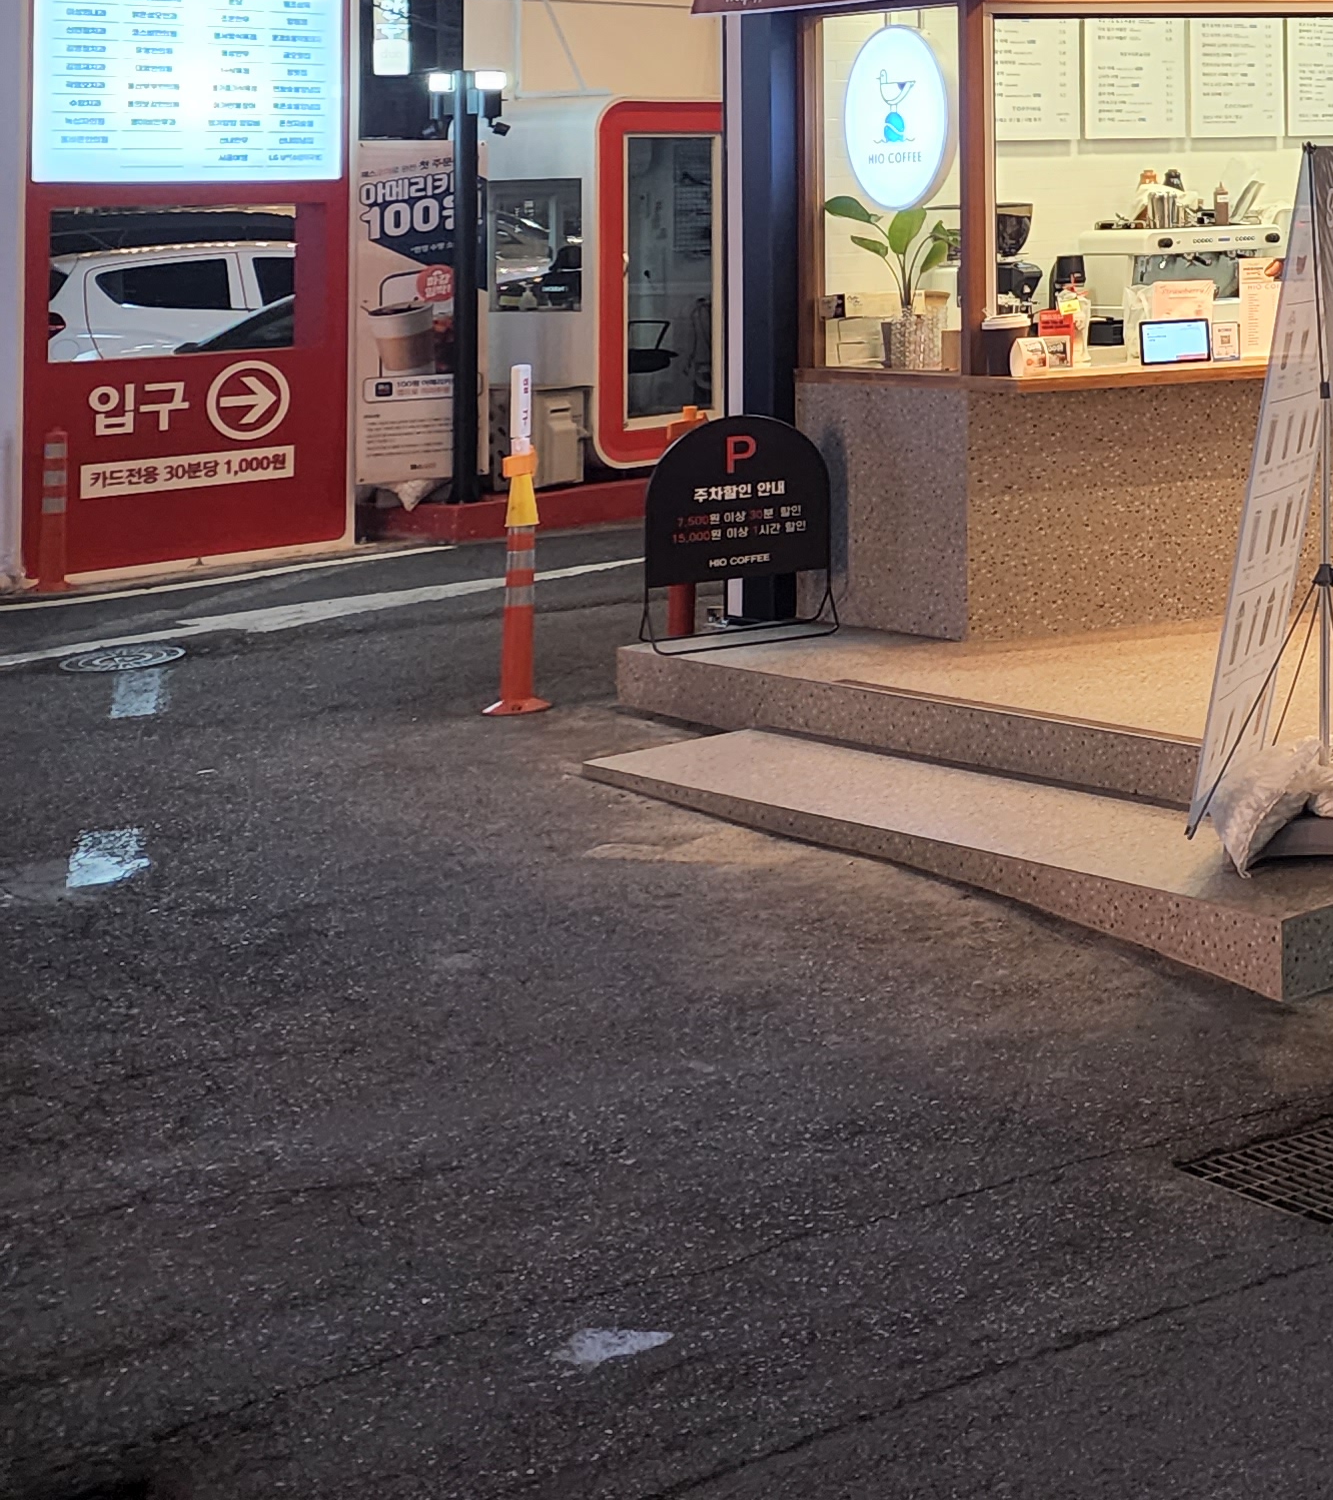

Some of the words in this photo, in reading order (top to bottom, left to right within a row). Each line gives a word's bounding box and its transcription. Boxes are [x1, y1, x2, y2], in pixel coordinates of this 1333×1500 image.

[868, 153, 884, 165] HIO
[888, 151, 922, 164] COFFEE
[88, 381, 190, 436] 입구
[725, 435, 757, 474] P
[90, 466, 160, 488] 카드전용
[163, 459, 219, 482] 30분당
[223, 453, 287, 477] 1,000원
[693, 483, 752, 503] 주차할인
[757, 480, 786, 497] 안내
[723, 510, 747, 523] 이상
[749, 508, 774, 520] 30분
[780, 505, 802, 517] 할인
[726, 526, 749, 539] 이상
[785, 520, 807, 533] 할인
[709, 559, 727, 568] HIO
[729, 553, 771, 567] COFFEE
